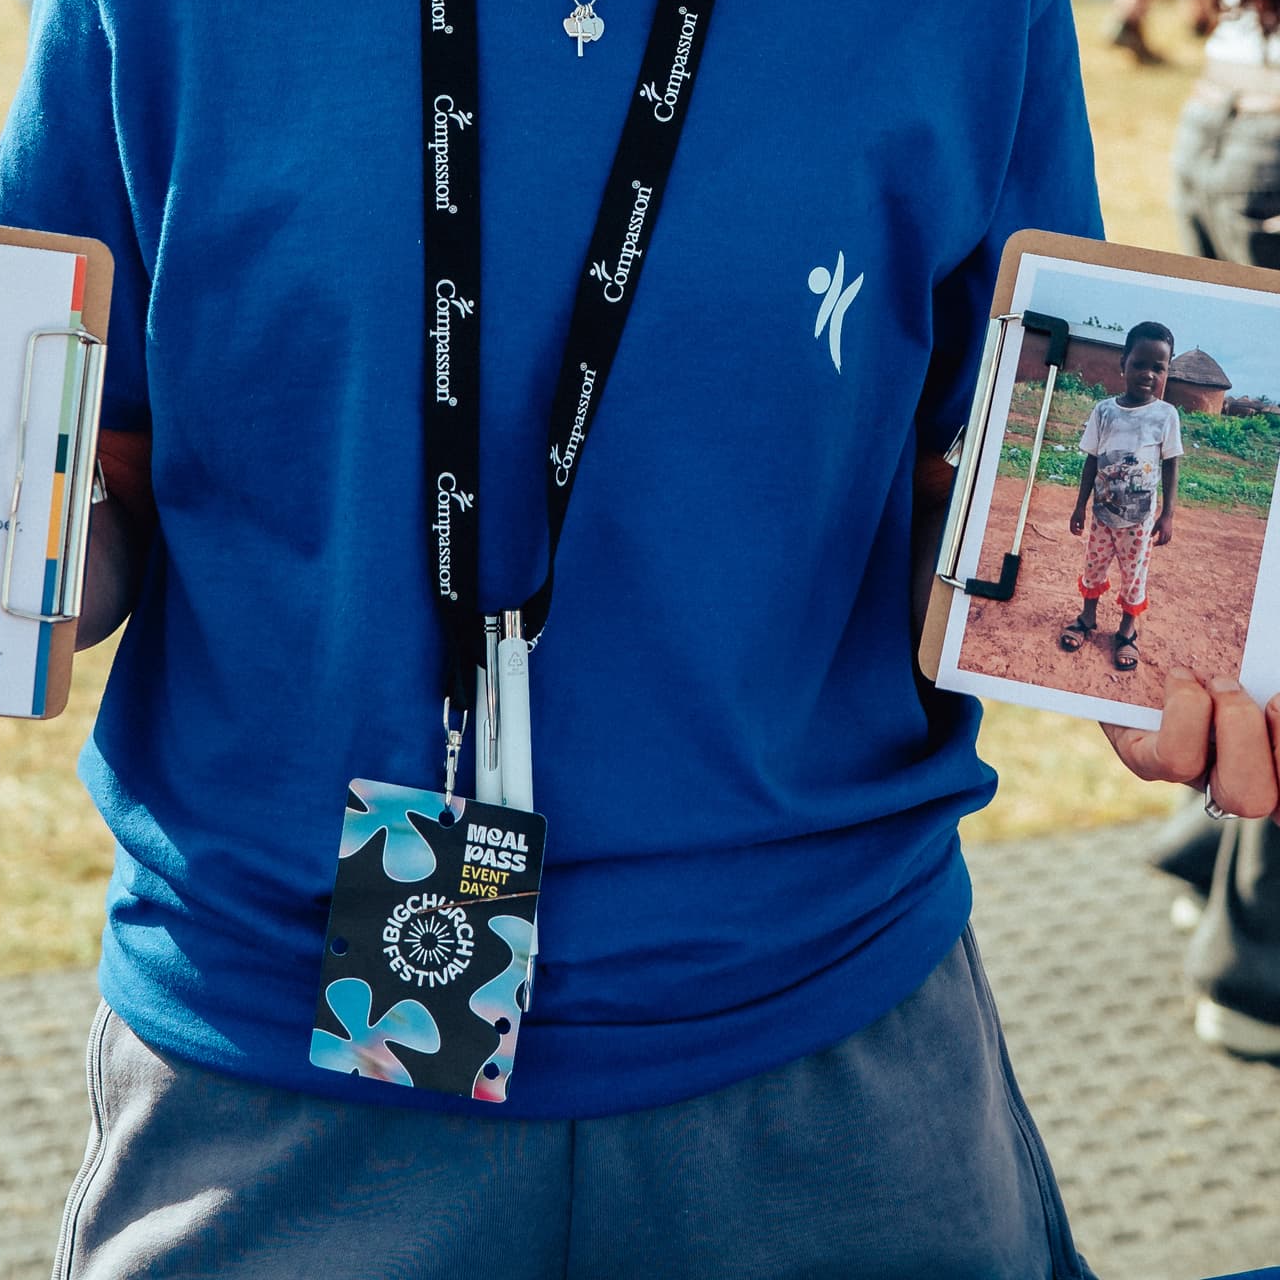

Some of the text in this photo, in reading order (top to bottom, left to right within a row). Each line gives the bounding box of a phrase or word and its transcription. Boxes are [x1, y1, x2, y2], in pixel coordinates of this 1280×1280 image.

[462, 864, 510, 886] EVENT
[460, 879, 498, 898] DAYS
[383, 944, 470, 987] FESTIVAL
